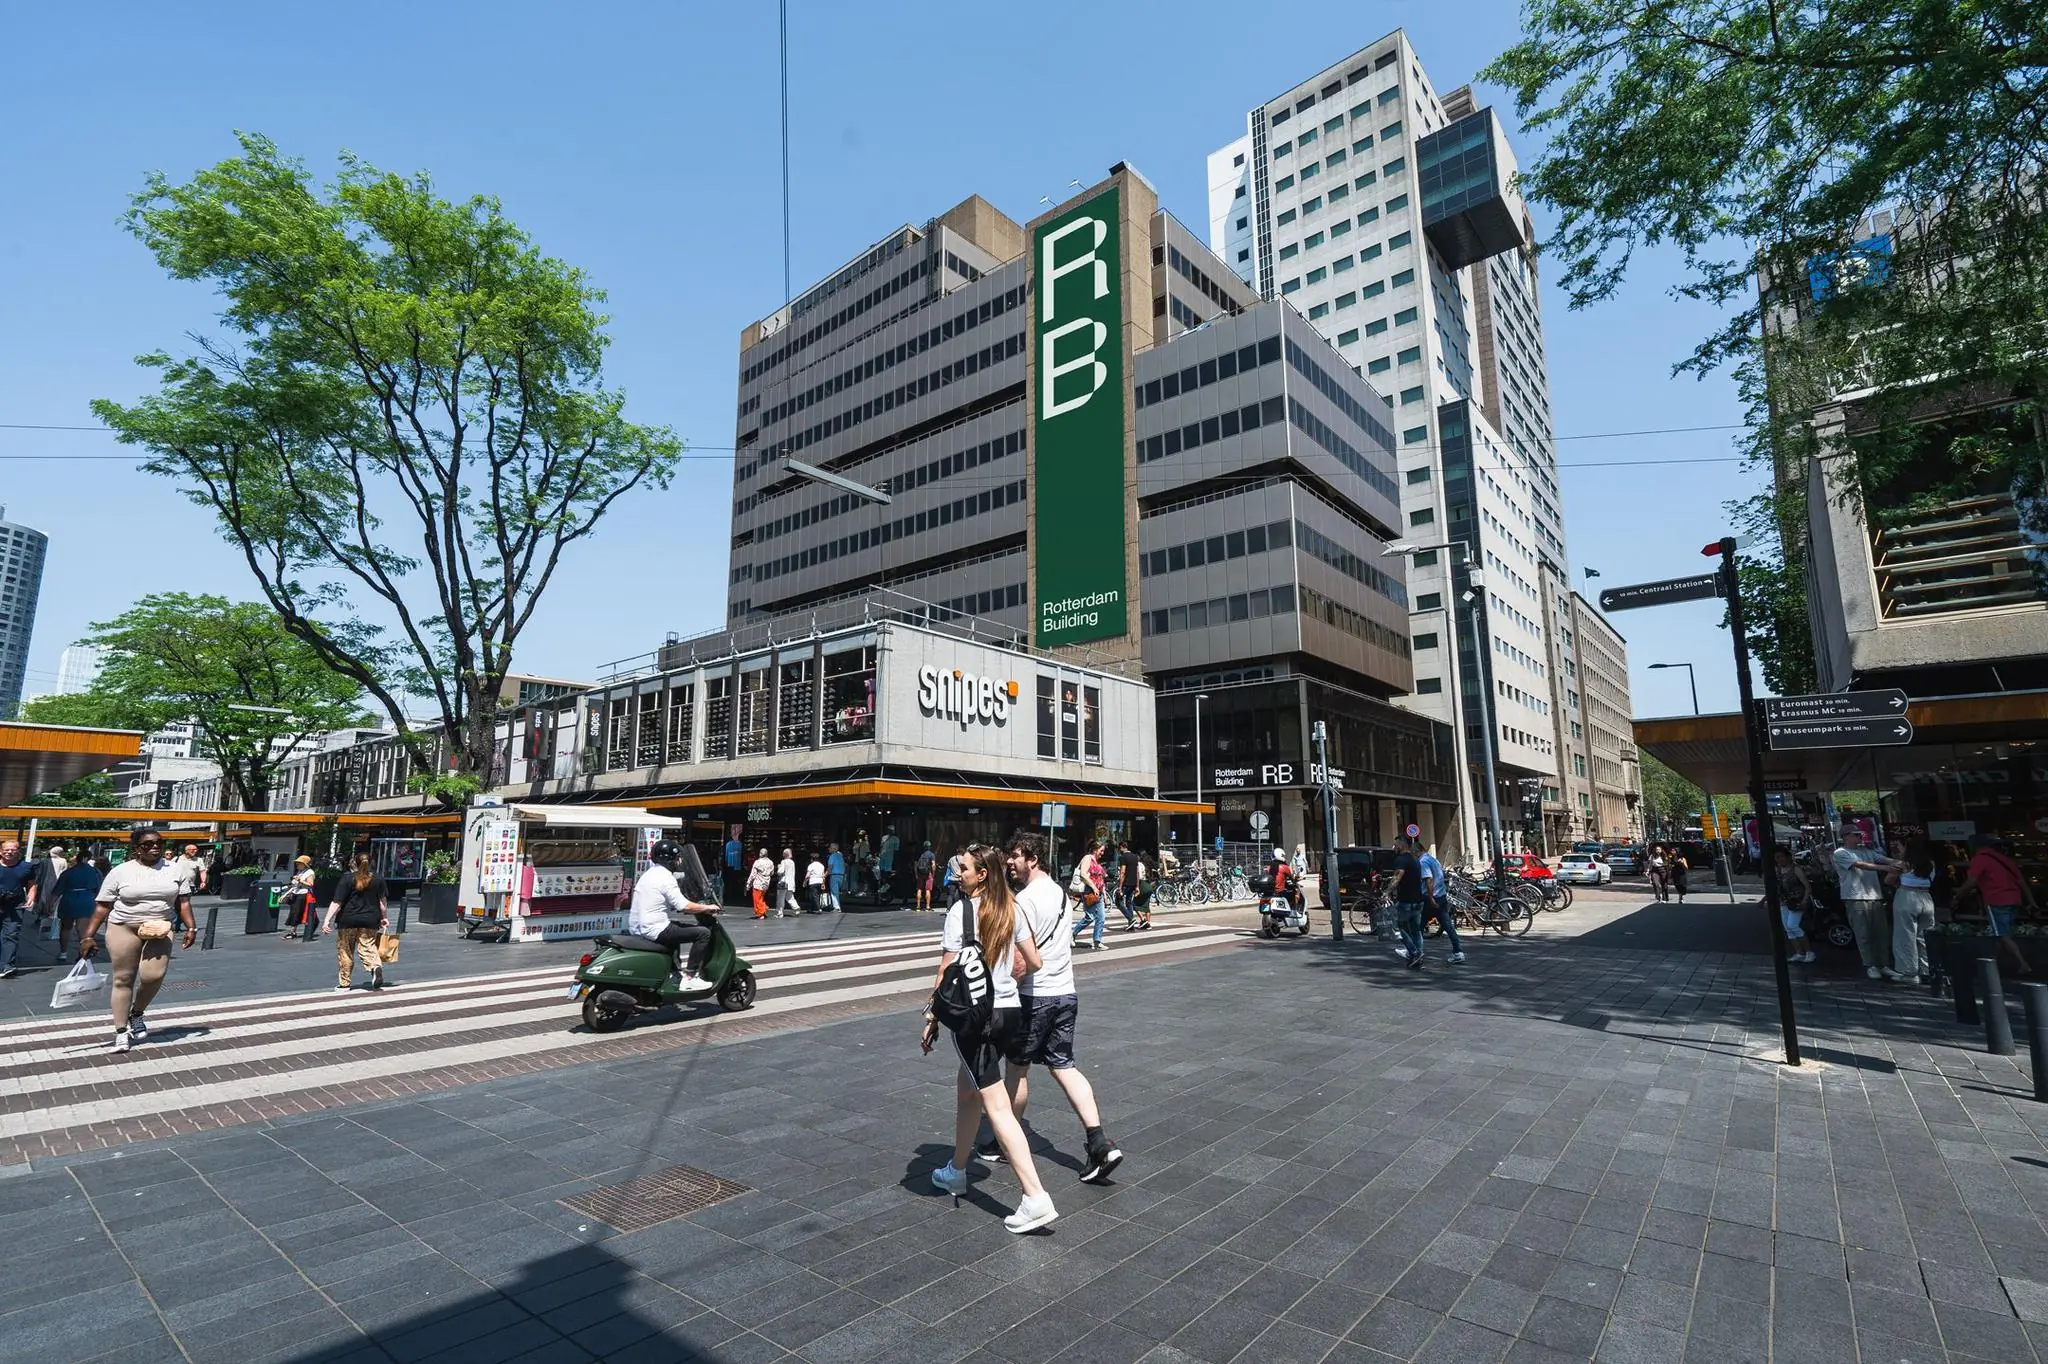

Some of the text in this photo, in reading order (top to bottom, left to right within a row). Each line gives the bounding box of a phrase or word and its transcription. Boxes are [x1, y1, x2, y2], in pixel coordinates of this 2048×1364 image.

[1639, 584, 1672, 594] Centraal
[1673, 580, 1703, 590] Station
[1043, 590, 1118, 617] Rotterdam
[1043, 612, 1099, 633] Building
[918, 664, 1009, 732] snipes
[1780, 699, 1824, 708] Euromast
[1781, 709, 1819, 718] Erasmus
[1821, 707, 1837, 715] MC
[1783, 725, 1843, 735] Museumpark
[352, 751, 362, 783] GUESS
[1215, 767, 1254, 777] Rotterdam
[1262, 763, 1293, 785] RB
[1215, 777, 1245, 787] Building
[1221, 803, 1246, 811] nomad
